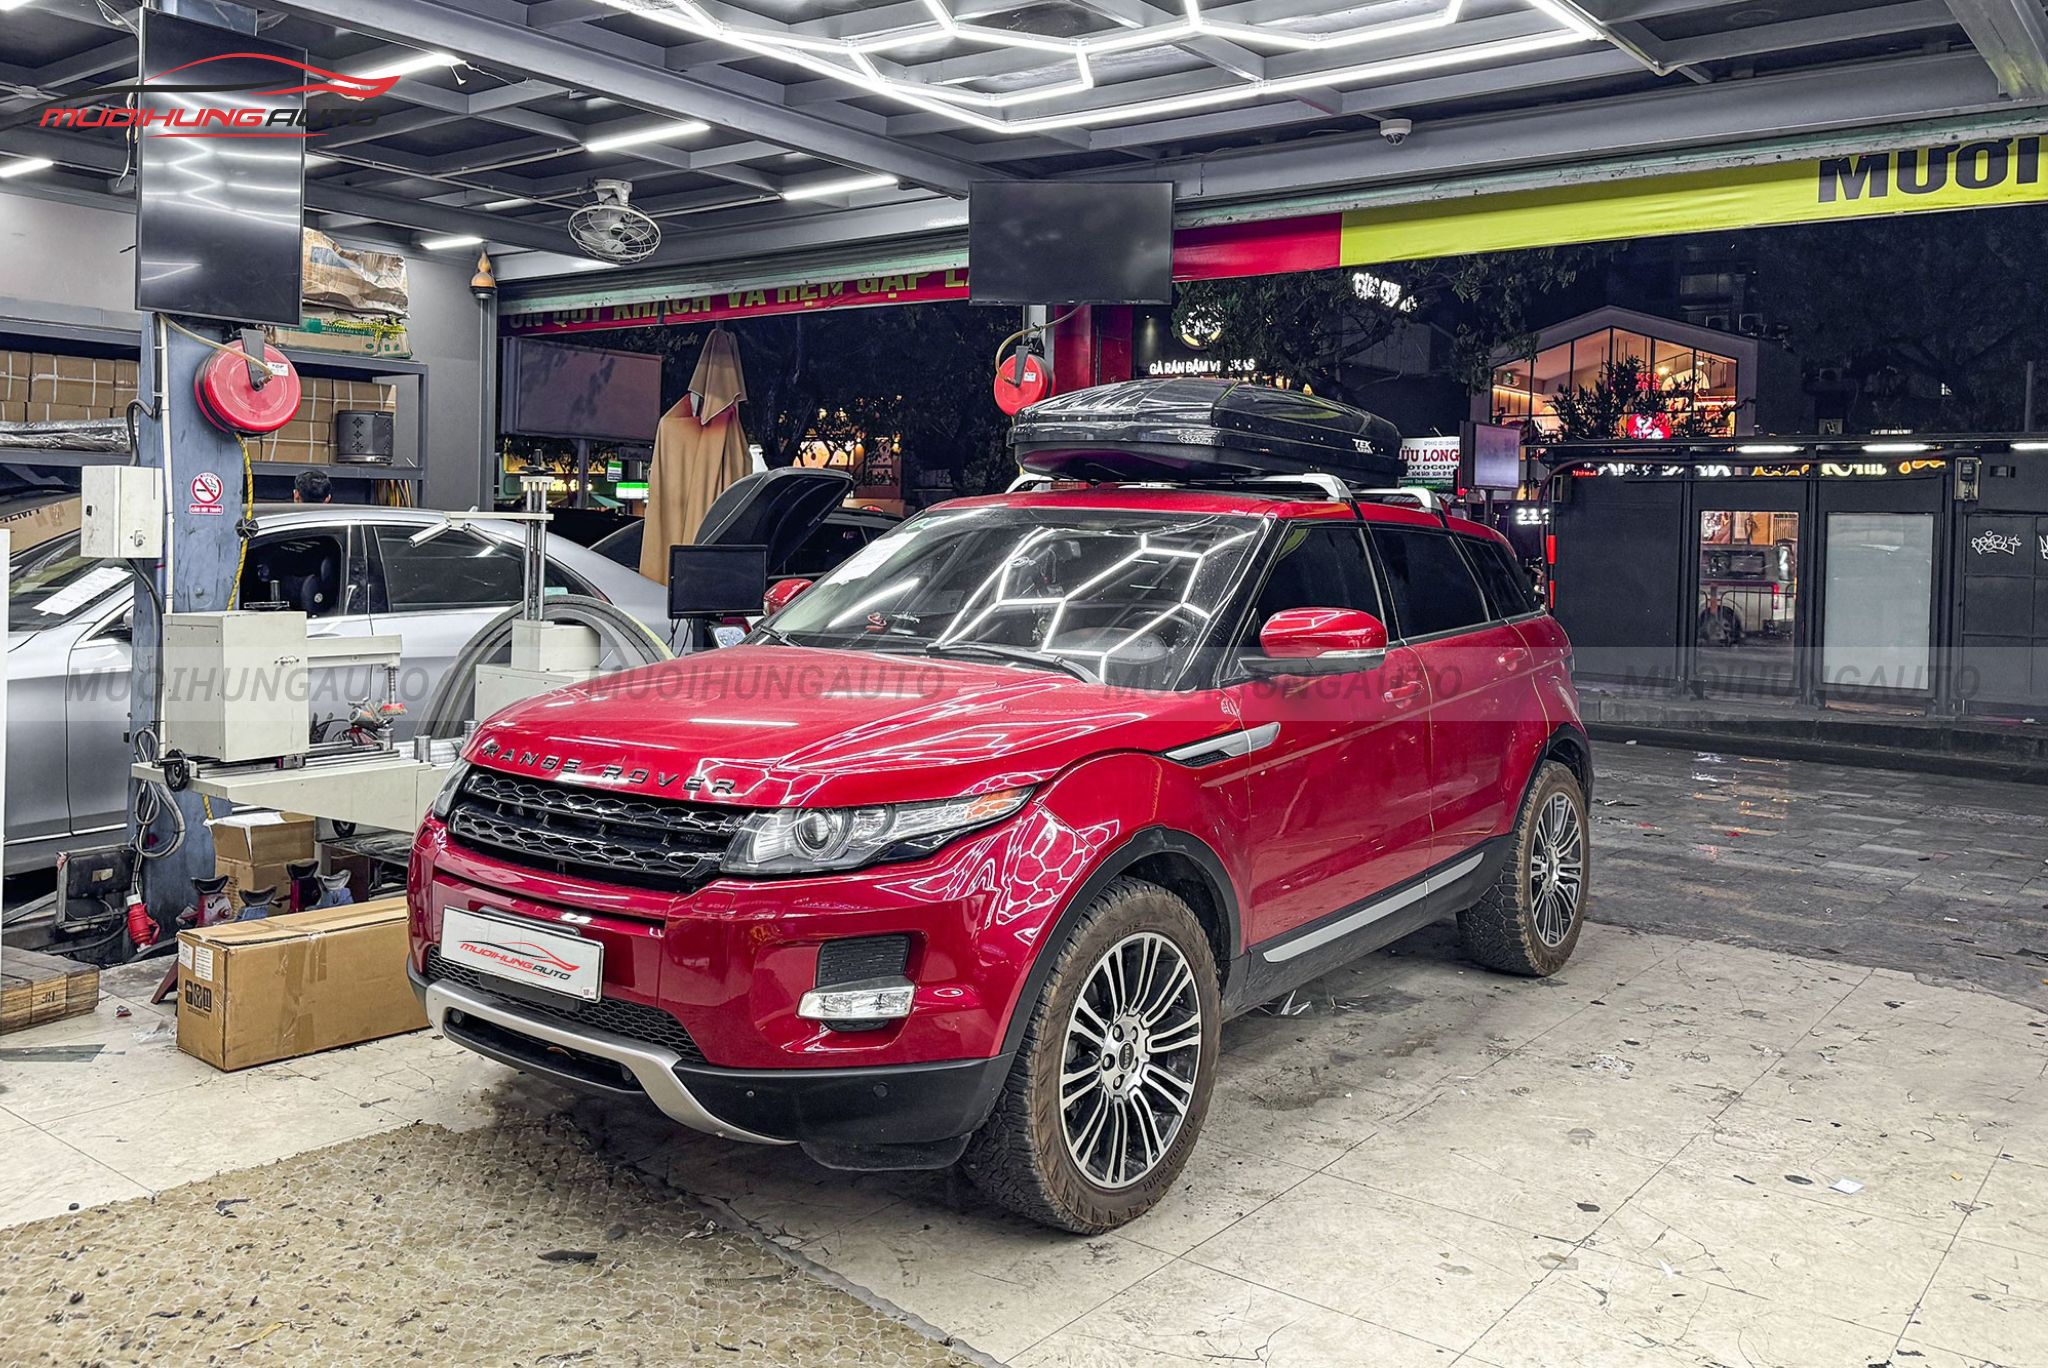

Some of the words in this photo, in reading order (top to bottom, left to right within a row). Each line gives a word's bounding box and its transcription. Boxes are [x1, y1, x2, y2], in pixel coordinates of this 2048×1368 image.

[1422, 449, 1459, 462] LONG
[482, 739, 583, 773] RANGE
[602, 763, 736, 795] ROVER
